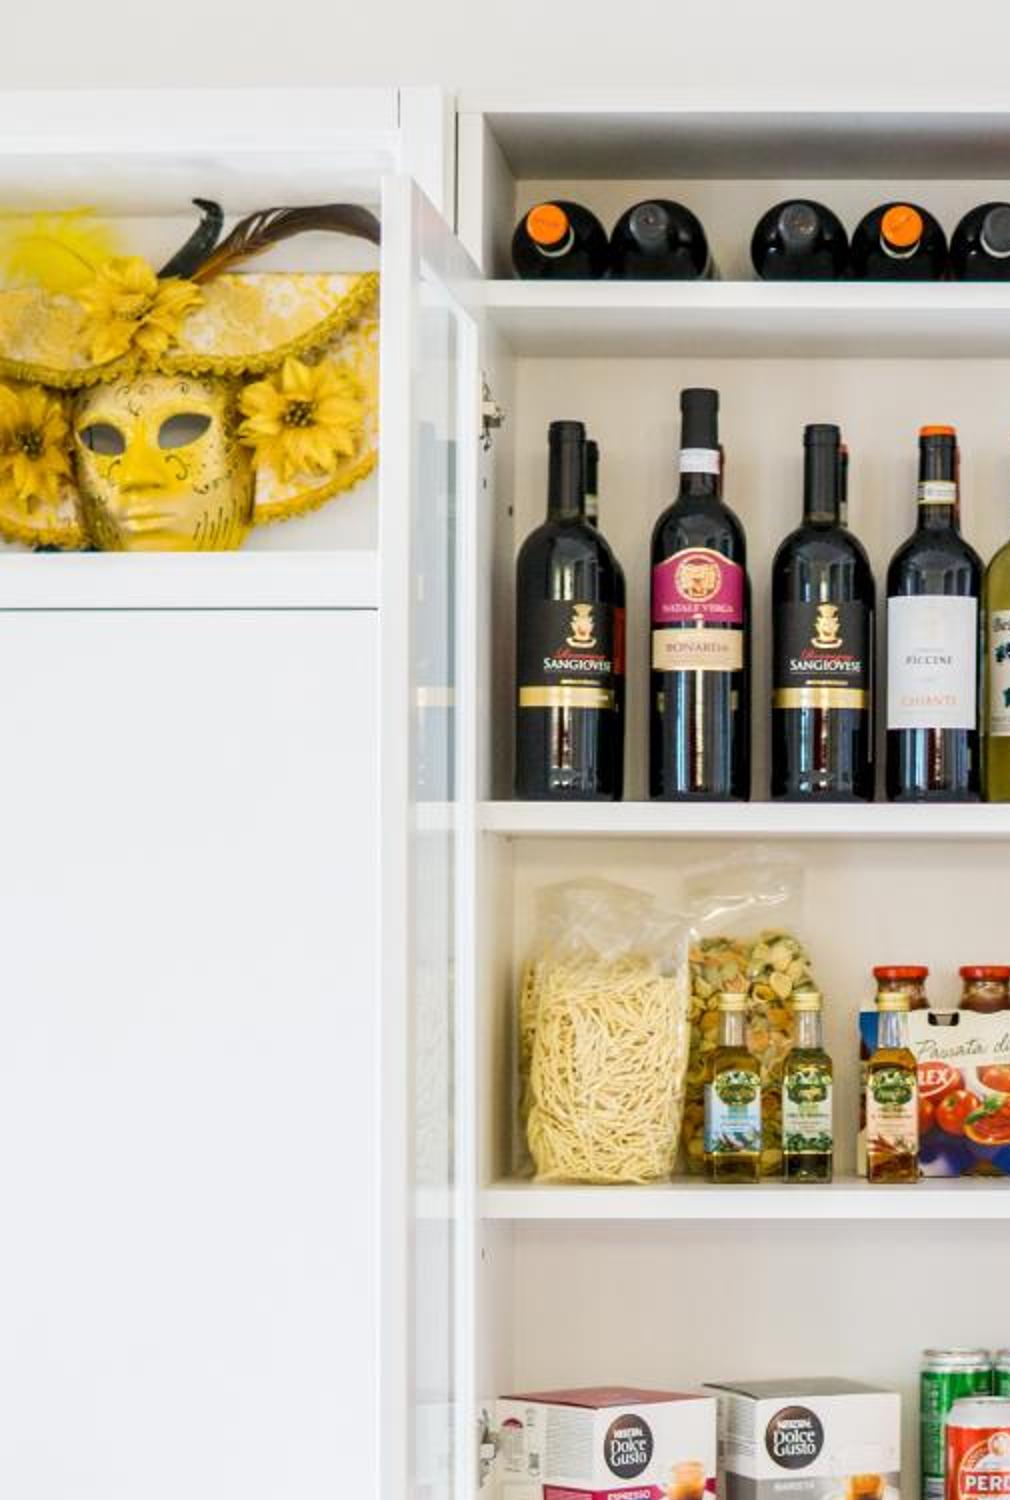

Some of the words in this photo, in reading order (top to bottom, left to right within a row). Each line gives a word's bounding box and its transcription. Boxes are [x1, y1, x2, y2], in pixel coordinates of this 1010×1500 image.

[789, 658, 862, 672] SANGIOVESE
[773, 1430, 815, 1445] Dolce
[611, 1440, 647, 1458] Dolce
[774, 1442, 816, 1457] Gusto
[611, 1452, 648, 1467] Gusto
